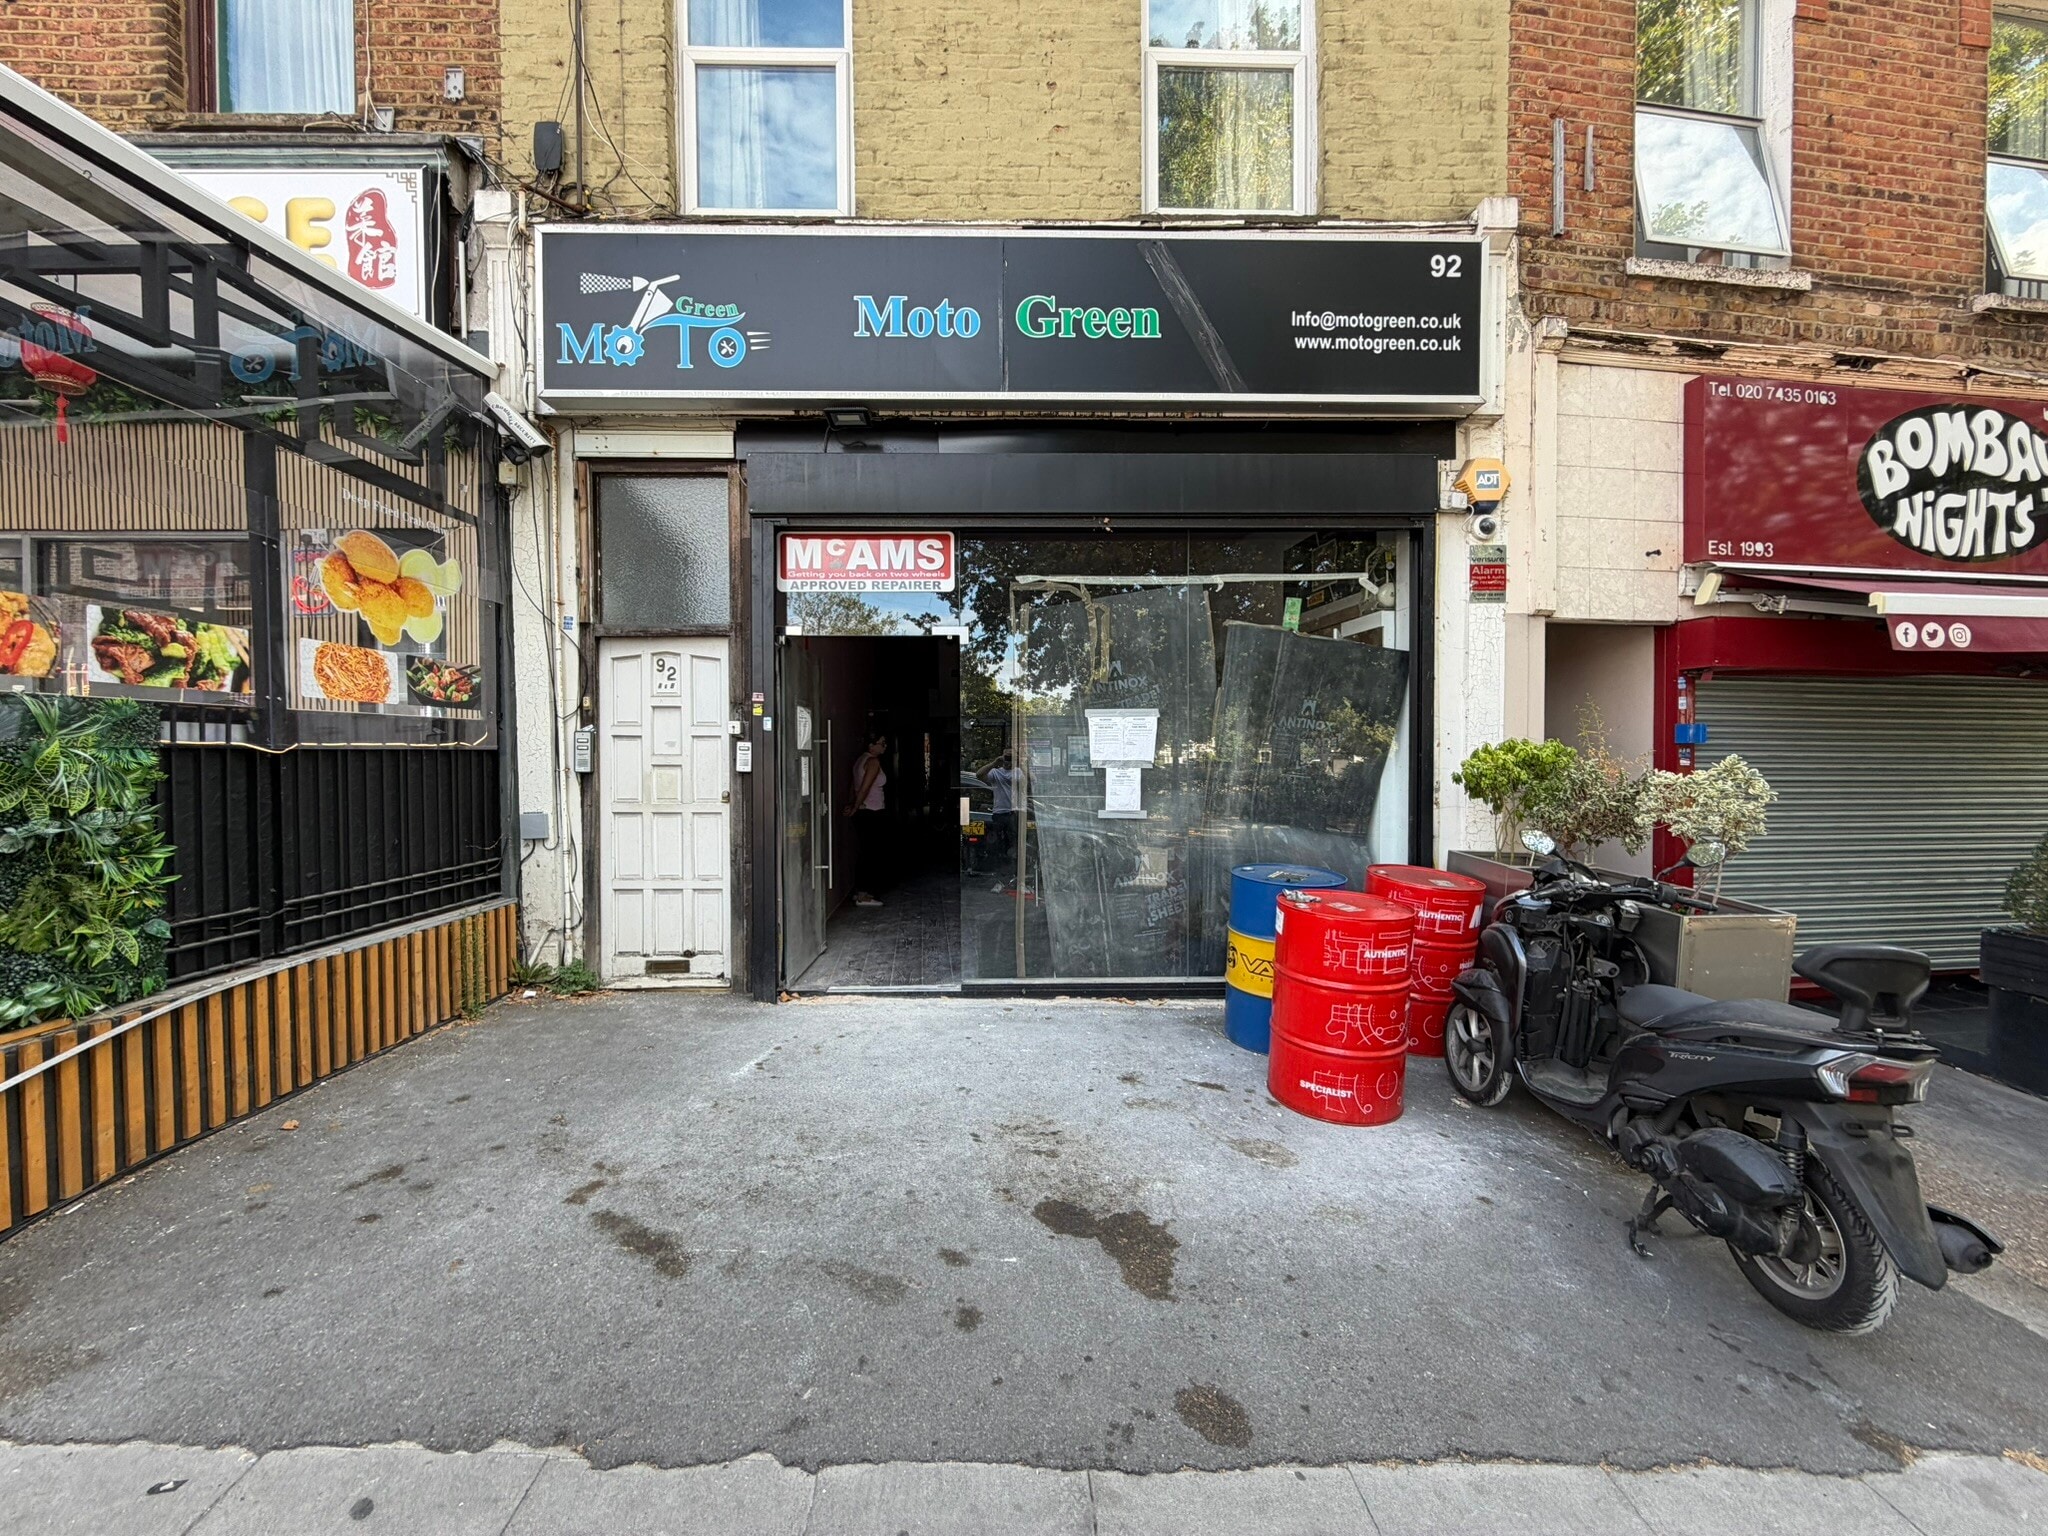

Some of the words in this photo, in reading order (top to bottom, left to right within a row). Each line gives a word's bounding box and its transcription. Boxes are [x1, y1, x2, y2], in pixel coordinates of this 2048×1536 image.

[227, 196, 337, 270] E
[1430, 254, 1462, 278] 92
[675, 295, 739, 318] Green
[853, 295, 981, 338] Moto
[1015, 294, 1161, 339] Green
[1291, 311, 1462, 331] Info@motogreen.co.uk
[1294, 335, 1461, 354] www.motogreen.co.uk
[1709, 382, 1733, 398] Tel.
[1736, 384, 1762, 399] 020
[1766, 387, 1801, 402] 7435
[1805, 390, 1836, 405] 0163
[1477, 473, 1499, 485] ADT
[342, 488, 370, 510] Deep
[373, 501, 400, 520] Fried
[402, 512, 424, 527] Crab
[1708, 540, 1735, 556] Est.
[1739, 541, 1774, 557] 1993
[788, 571, 825, 579] Getting
[1472, 566, 1505, 574] Alarm
[790, 581, 866, 590] APPROVED
[872, 581, 942, 590] REPAIRER
[656, 658, 677, 681] 92
[1418, 910, 1463, 921] AUTHENTIC
[1363, 950, 1407, 959] AUTHENTIC
[1299, 1079, 1353, 1099] SPECIALIST
